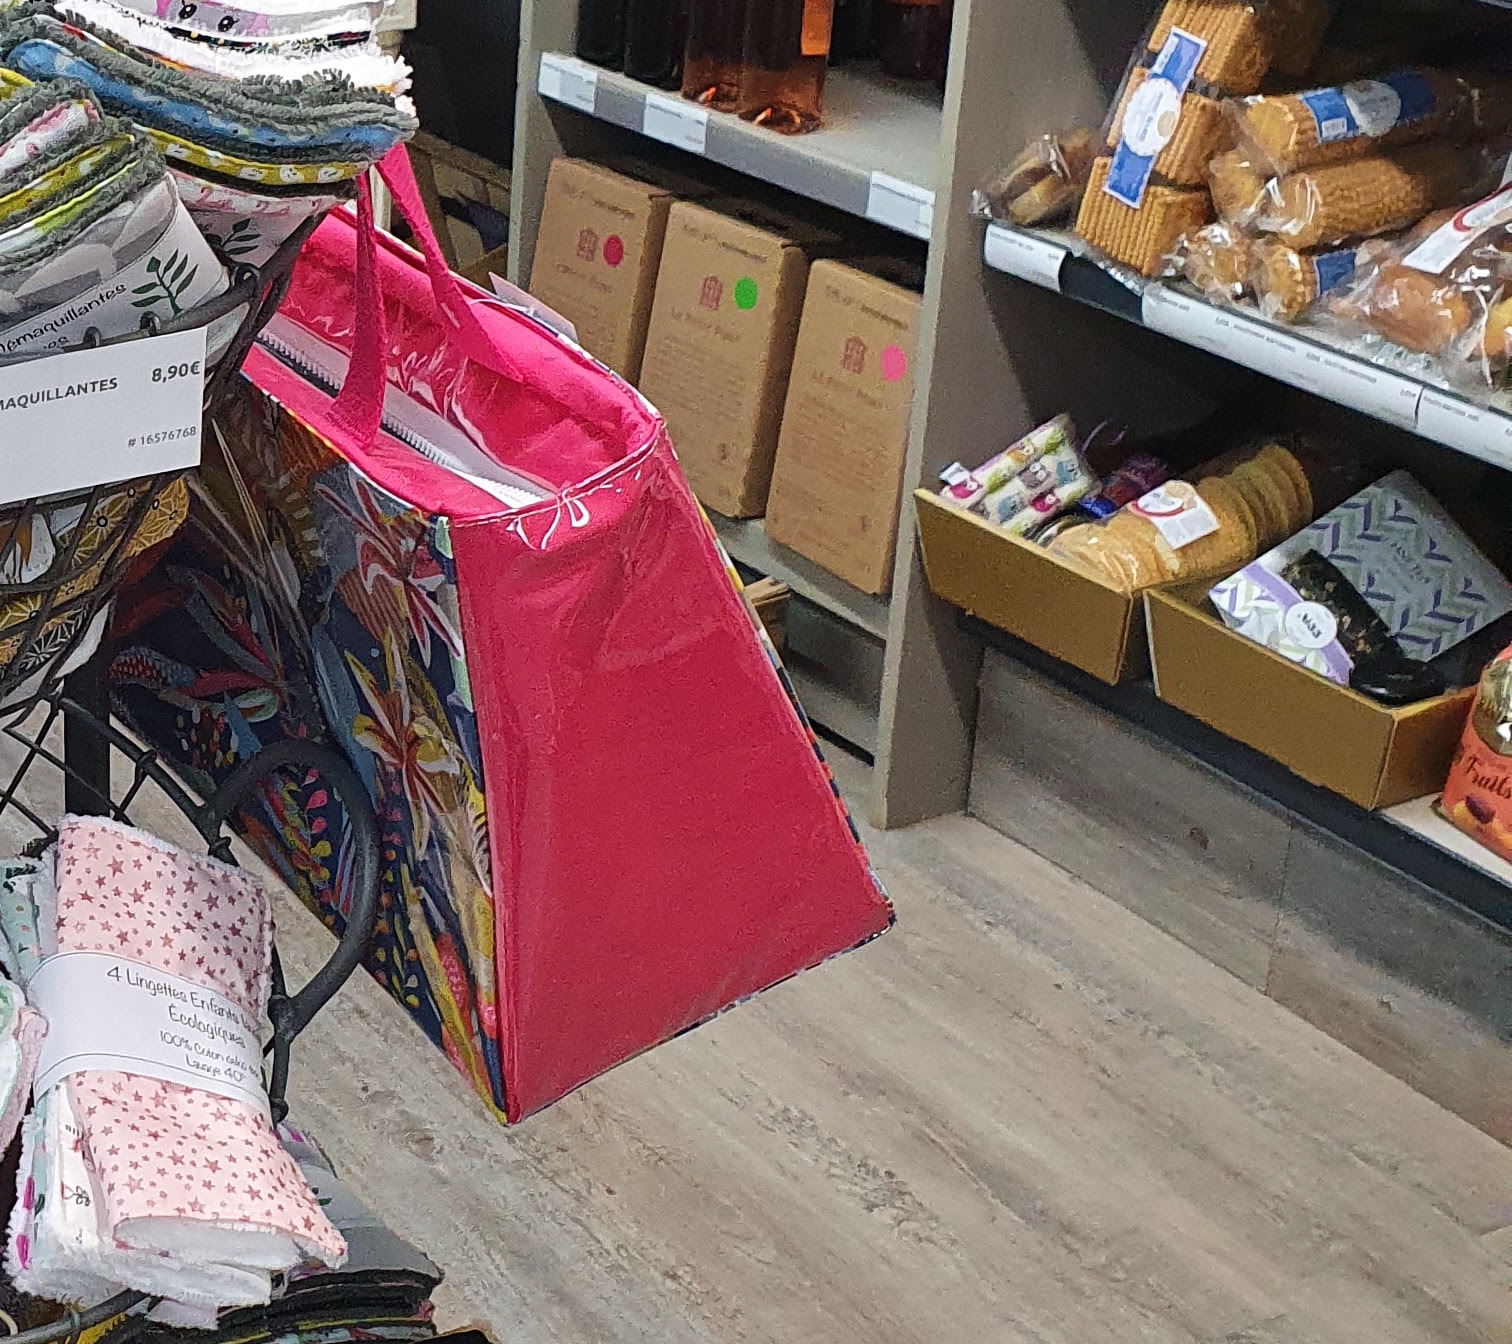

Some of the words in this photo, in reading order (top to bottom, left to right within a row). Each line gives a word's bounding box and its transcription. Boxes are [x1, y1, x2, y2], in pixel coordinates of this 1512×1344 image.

[151, 360, 201, 384] 8,90€
[140, 425, 197, 446] 16576768
[107, 966, 122, 982] 4
[126, 968, 188, 1003] Lingettes
